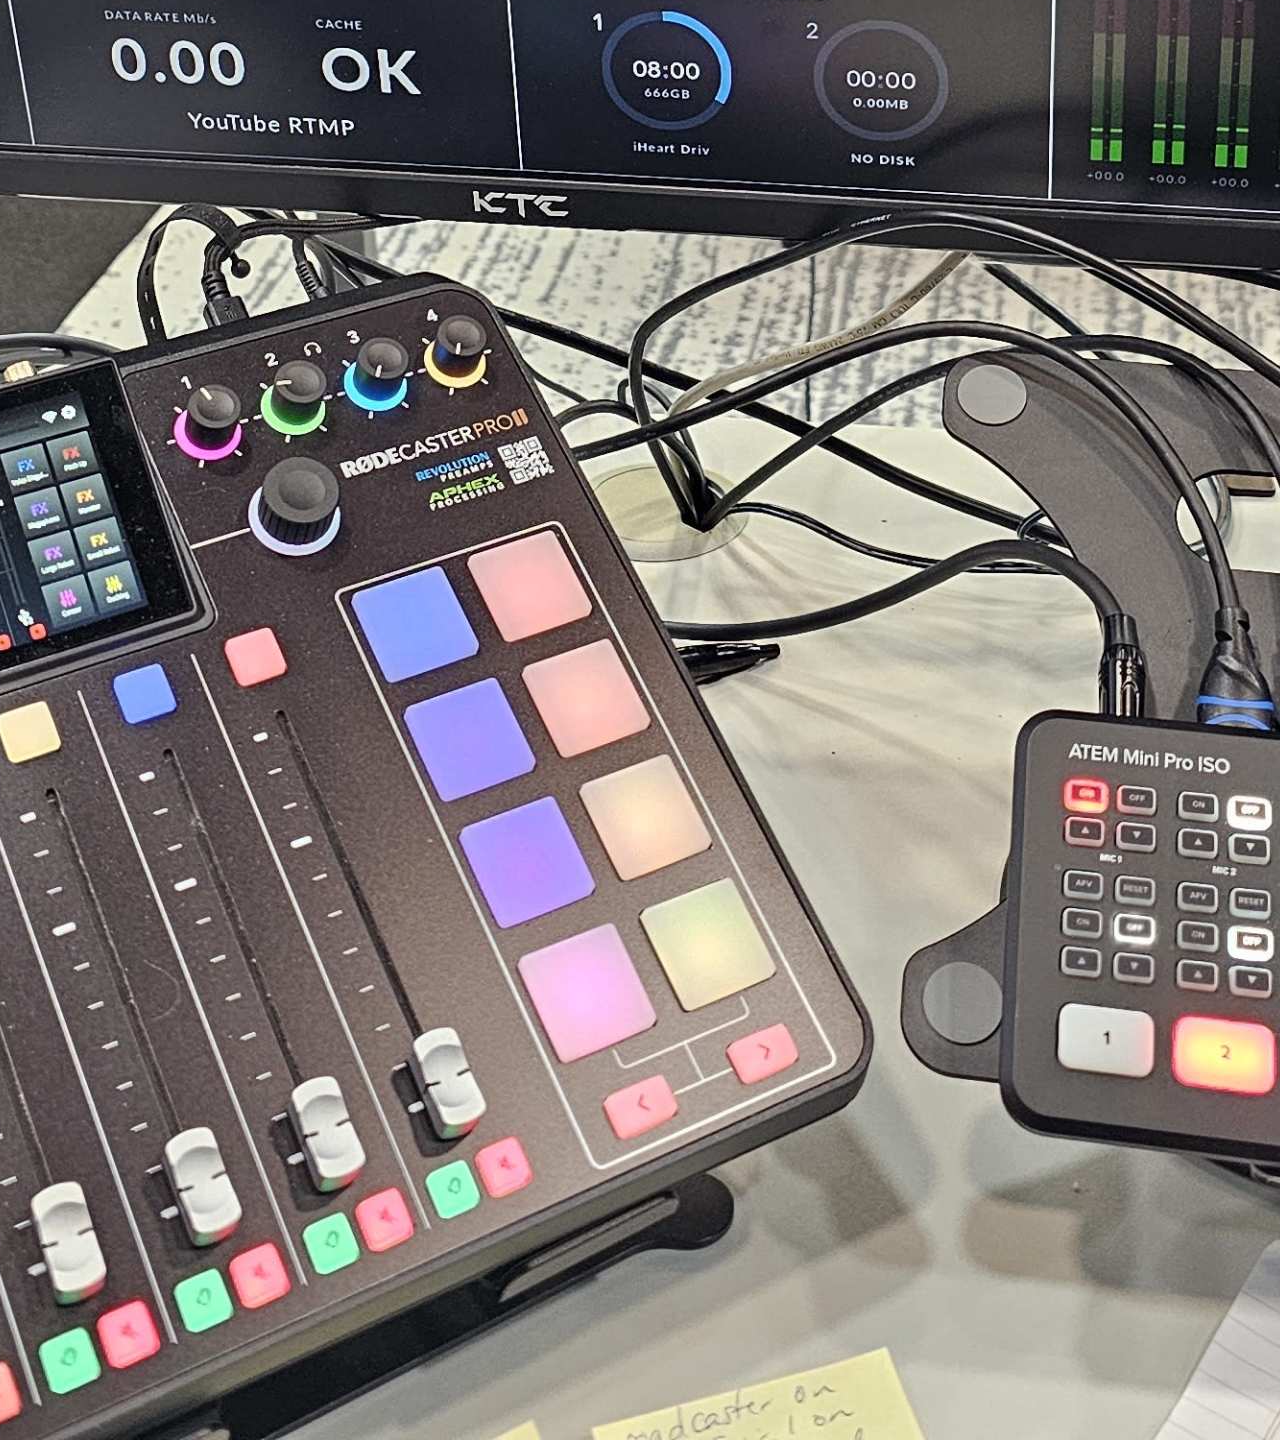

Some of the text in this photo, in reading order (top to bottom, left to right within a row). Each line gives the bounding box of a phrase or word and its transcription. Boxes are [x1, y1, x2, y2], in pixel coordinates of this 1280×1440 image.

[104, 10, 217, 25] DATA RATE Mb/s
[315, 18, 362, 30] CACHE
[592, 13, 603, 32] 1
[806, 23, 818, 40] 2
[111, 37, 245, 87] 0.00
[321, 47, 421, 95] OK
[632, 61, 700, 81] 08:00
[846, 70, 916, 90] 00:00
[644, 87, 691, 100] 666GB
[853, 97, 909, 111] 0.00MB
[187, 111, 355, 136] YouTube RTMP
[633, 141, 710, 157] iHeart Driv
[851, 153, 916, 167] NO DISK
[473, 191, 569, 218] KTC
[427, 309, 438, 321] 4
[347, 330, 360, 344] 3
[265, 353, 278, 367] 2
[181, 376, 191, 389] 1
[62, 447, 80, 459] FX
[17, 459, 35, 471] FX
[416, 452, 490, 481] REVOLUTION
[440, 461, 493, 482] PREAMPS
[429, 473, 500, 503] APHEX
[76, 490, 94, 503] FX
[429, 483, 505, 511] PROCESSING
[31, 502, 48, 515] FX
[90, 532, 108, 546] FX
[44, 547, 62, 560] FX
[1069, 743, 1230, 774] ATEM Mini Pro ISO
[1192, 800, 1205, 809] ON
[1103, 1031, 1110, 1044] 1
[1220, 1045, 1230, 1059] 2
